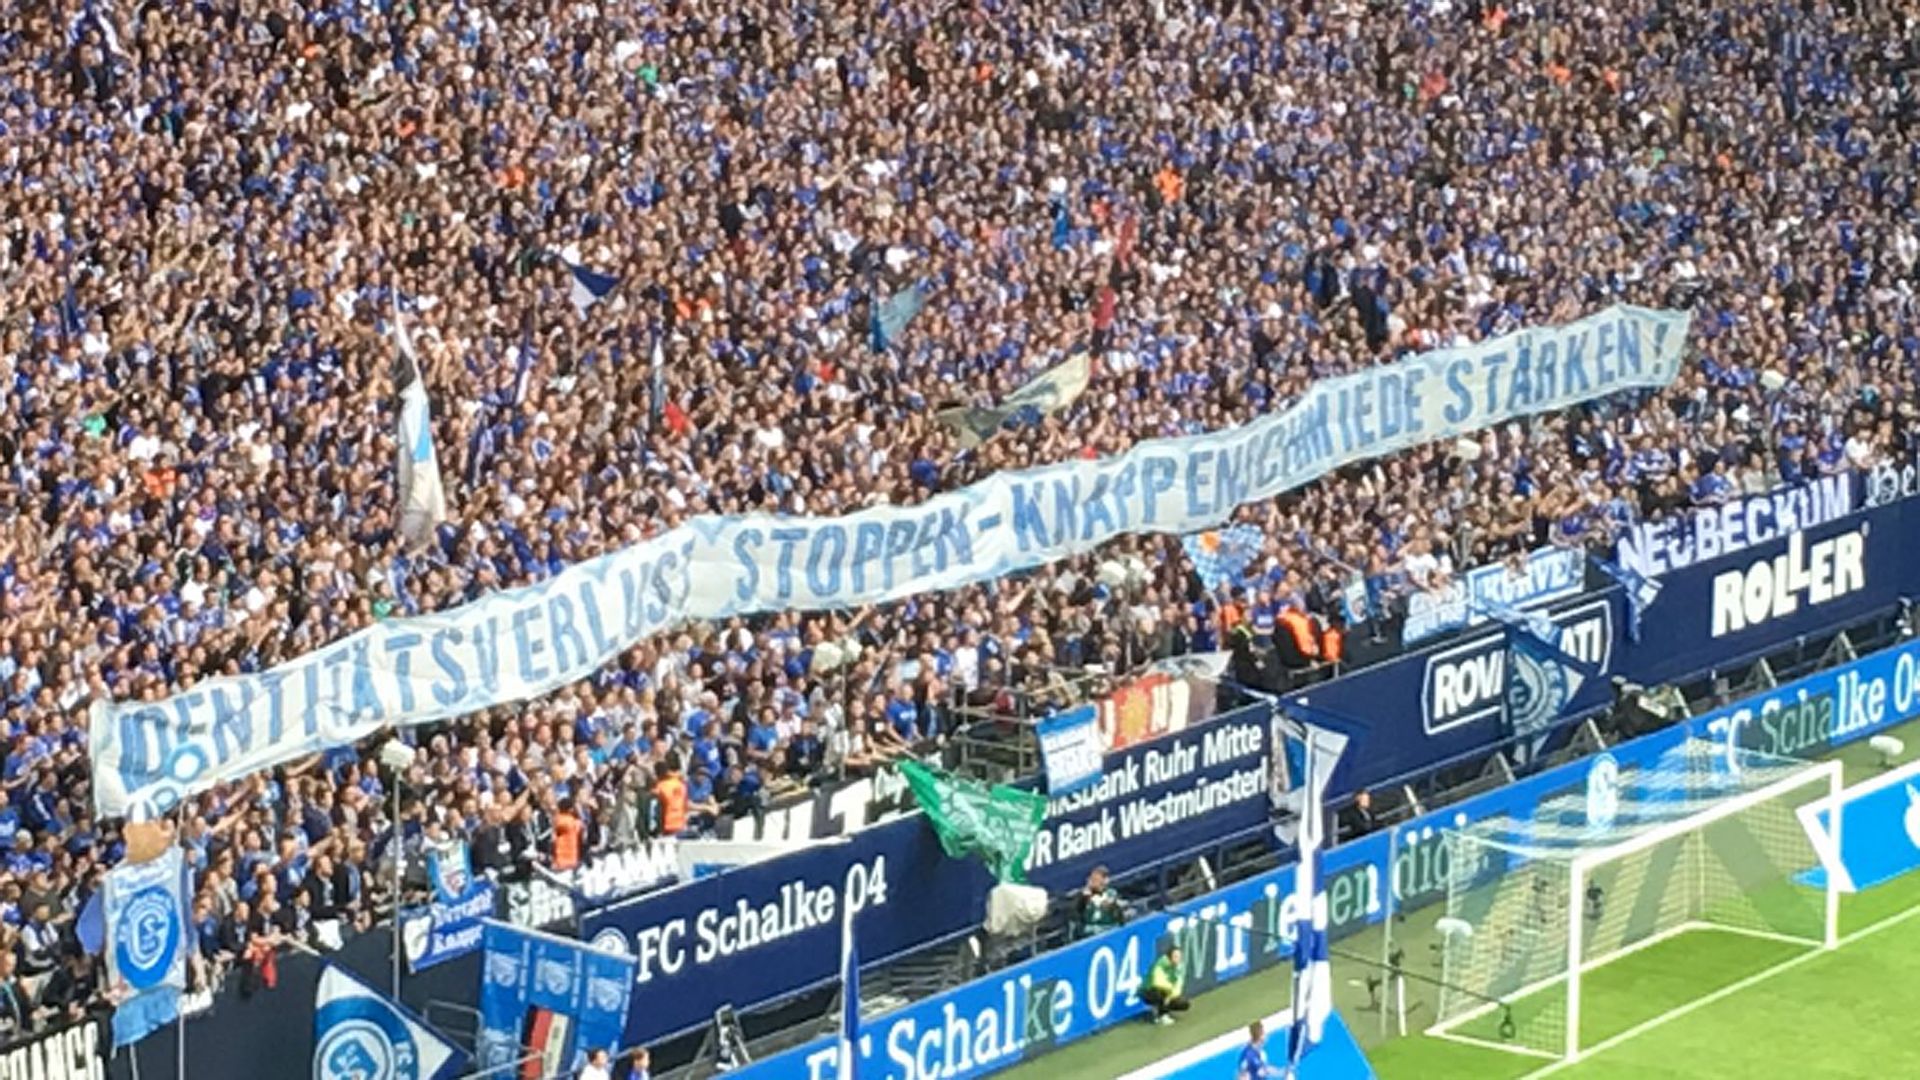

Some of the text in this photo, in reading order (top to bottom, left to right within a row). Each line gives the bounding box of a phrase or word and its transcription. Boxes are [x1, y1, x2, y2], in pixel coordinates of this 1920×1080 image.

[1617, 473, 1850, 577] NEUBECKUM
[1144, 739, 1199, 786] Ruhr
[1203, 723, 1263, 767] Mitte
[1761, 669, 1886, 757] Schalke
[1057, 809, 1116, 860] Bank
[637, 922, 686, 983] FC
[697, 882, 836, 964] Schalke
[848, 855, 888, 914] 04
[887, 975, 1074, 1080] Schalke
[1087, 935, 1143, 1019] 04
[1167, 902, 1252, 978] Wir
[1263, 864, 1381, 952] leen
